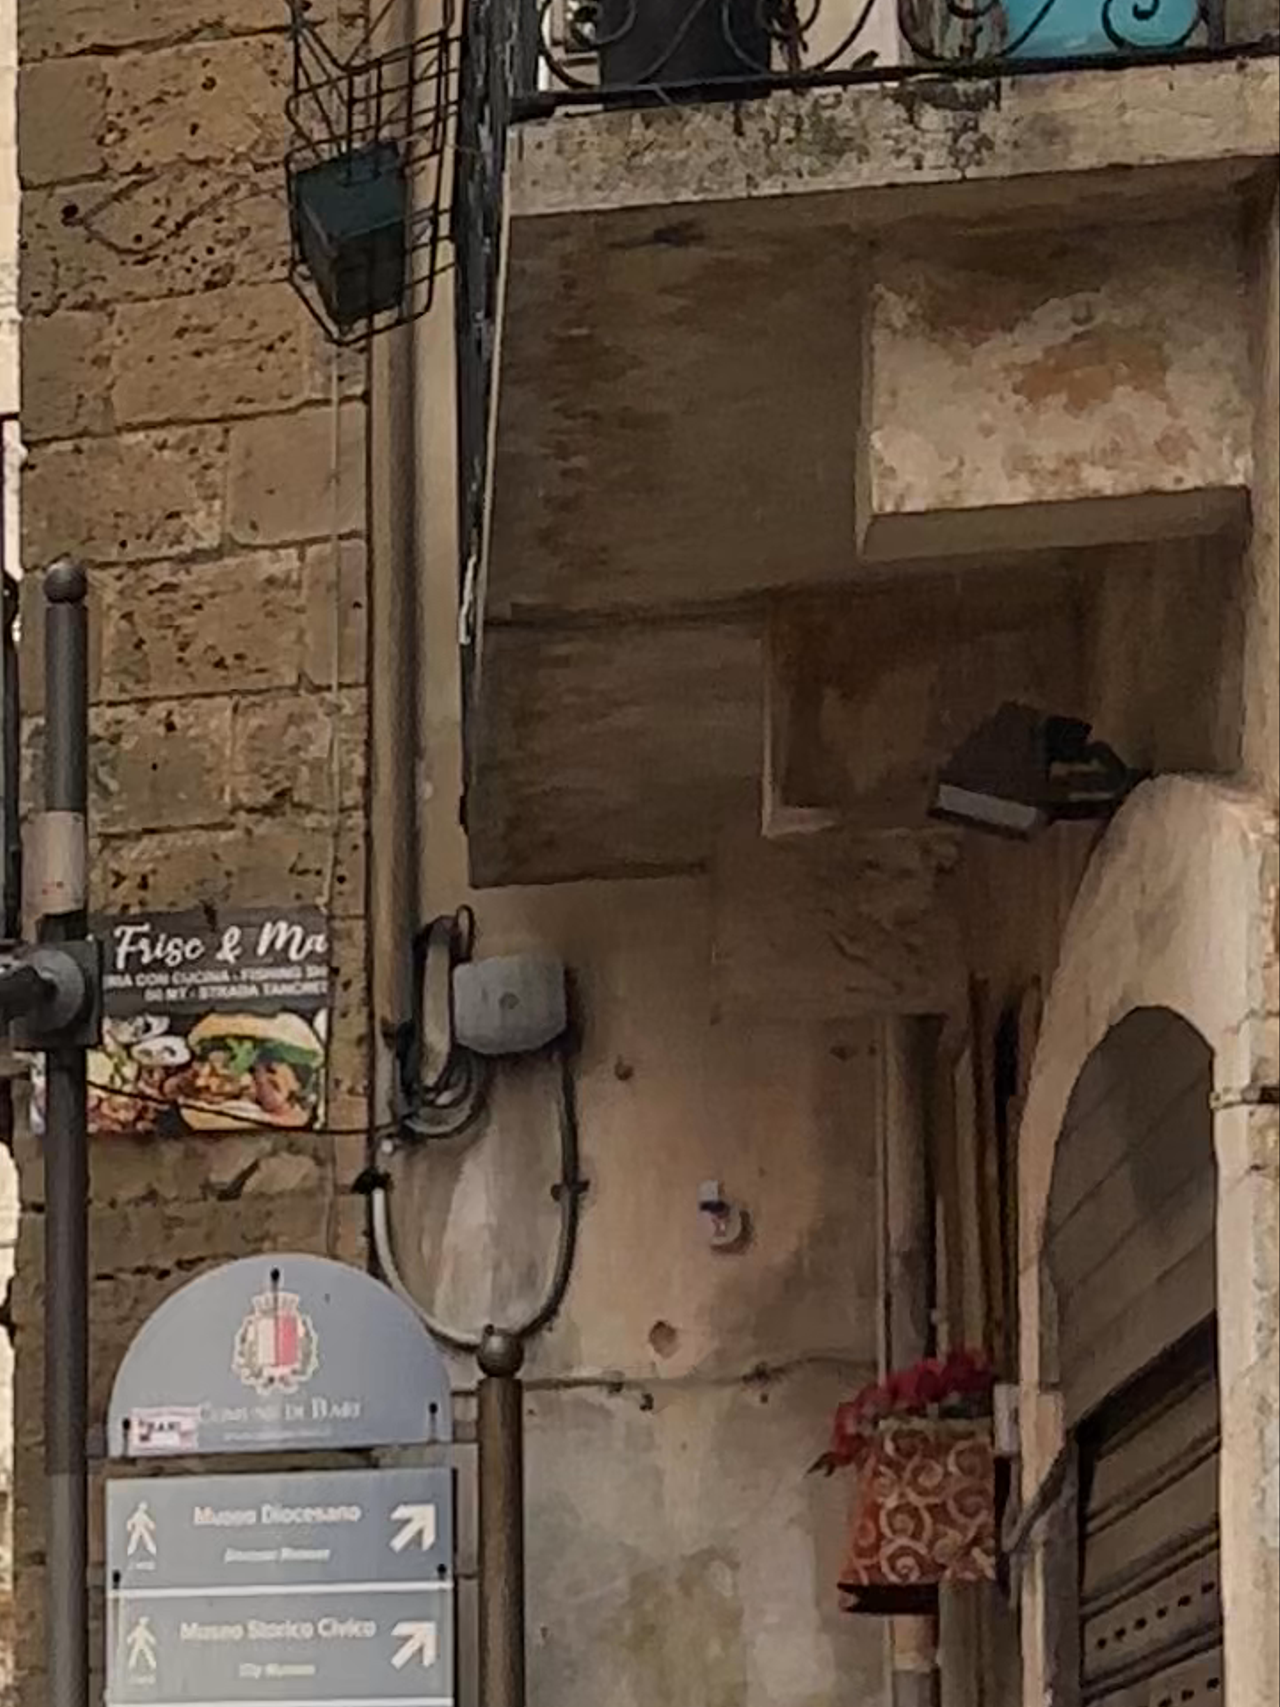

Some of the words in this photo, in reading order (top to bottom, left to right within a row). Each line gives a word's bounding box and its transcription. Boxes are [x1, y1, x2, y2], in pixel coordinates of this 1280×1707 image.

[215, 924, 243, 964] &
[260, 1502, 362, 1523] Diocesano
[180, 1621, 244, 1641] Museo
[247, 1619, 314, 1640] Storico
[317, 1616, 377, 1638] Civico
